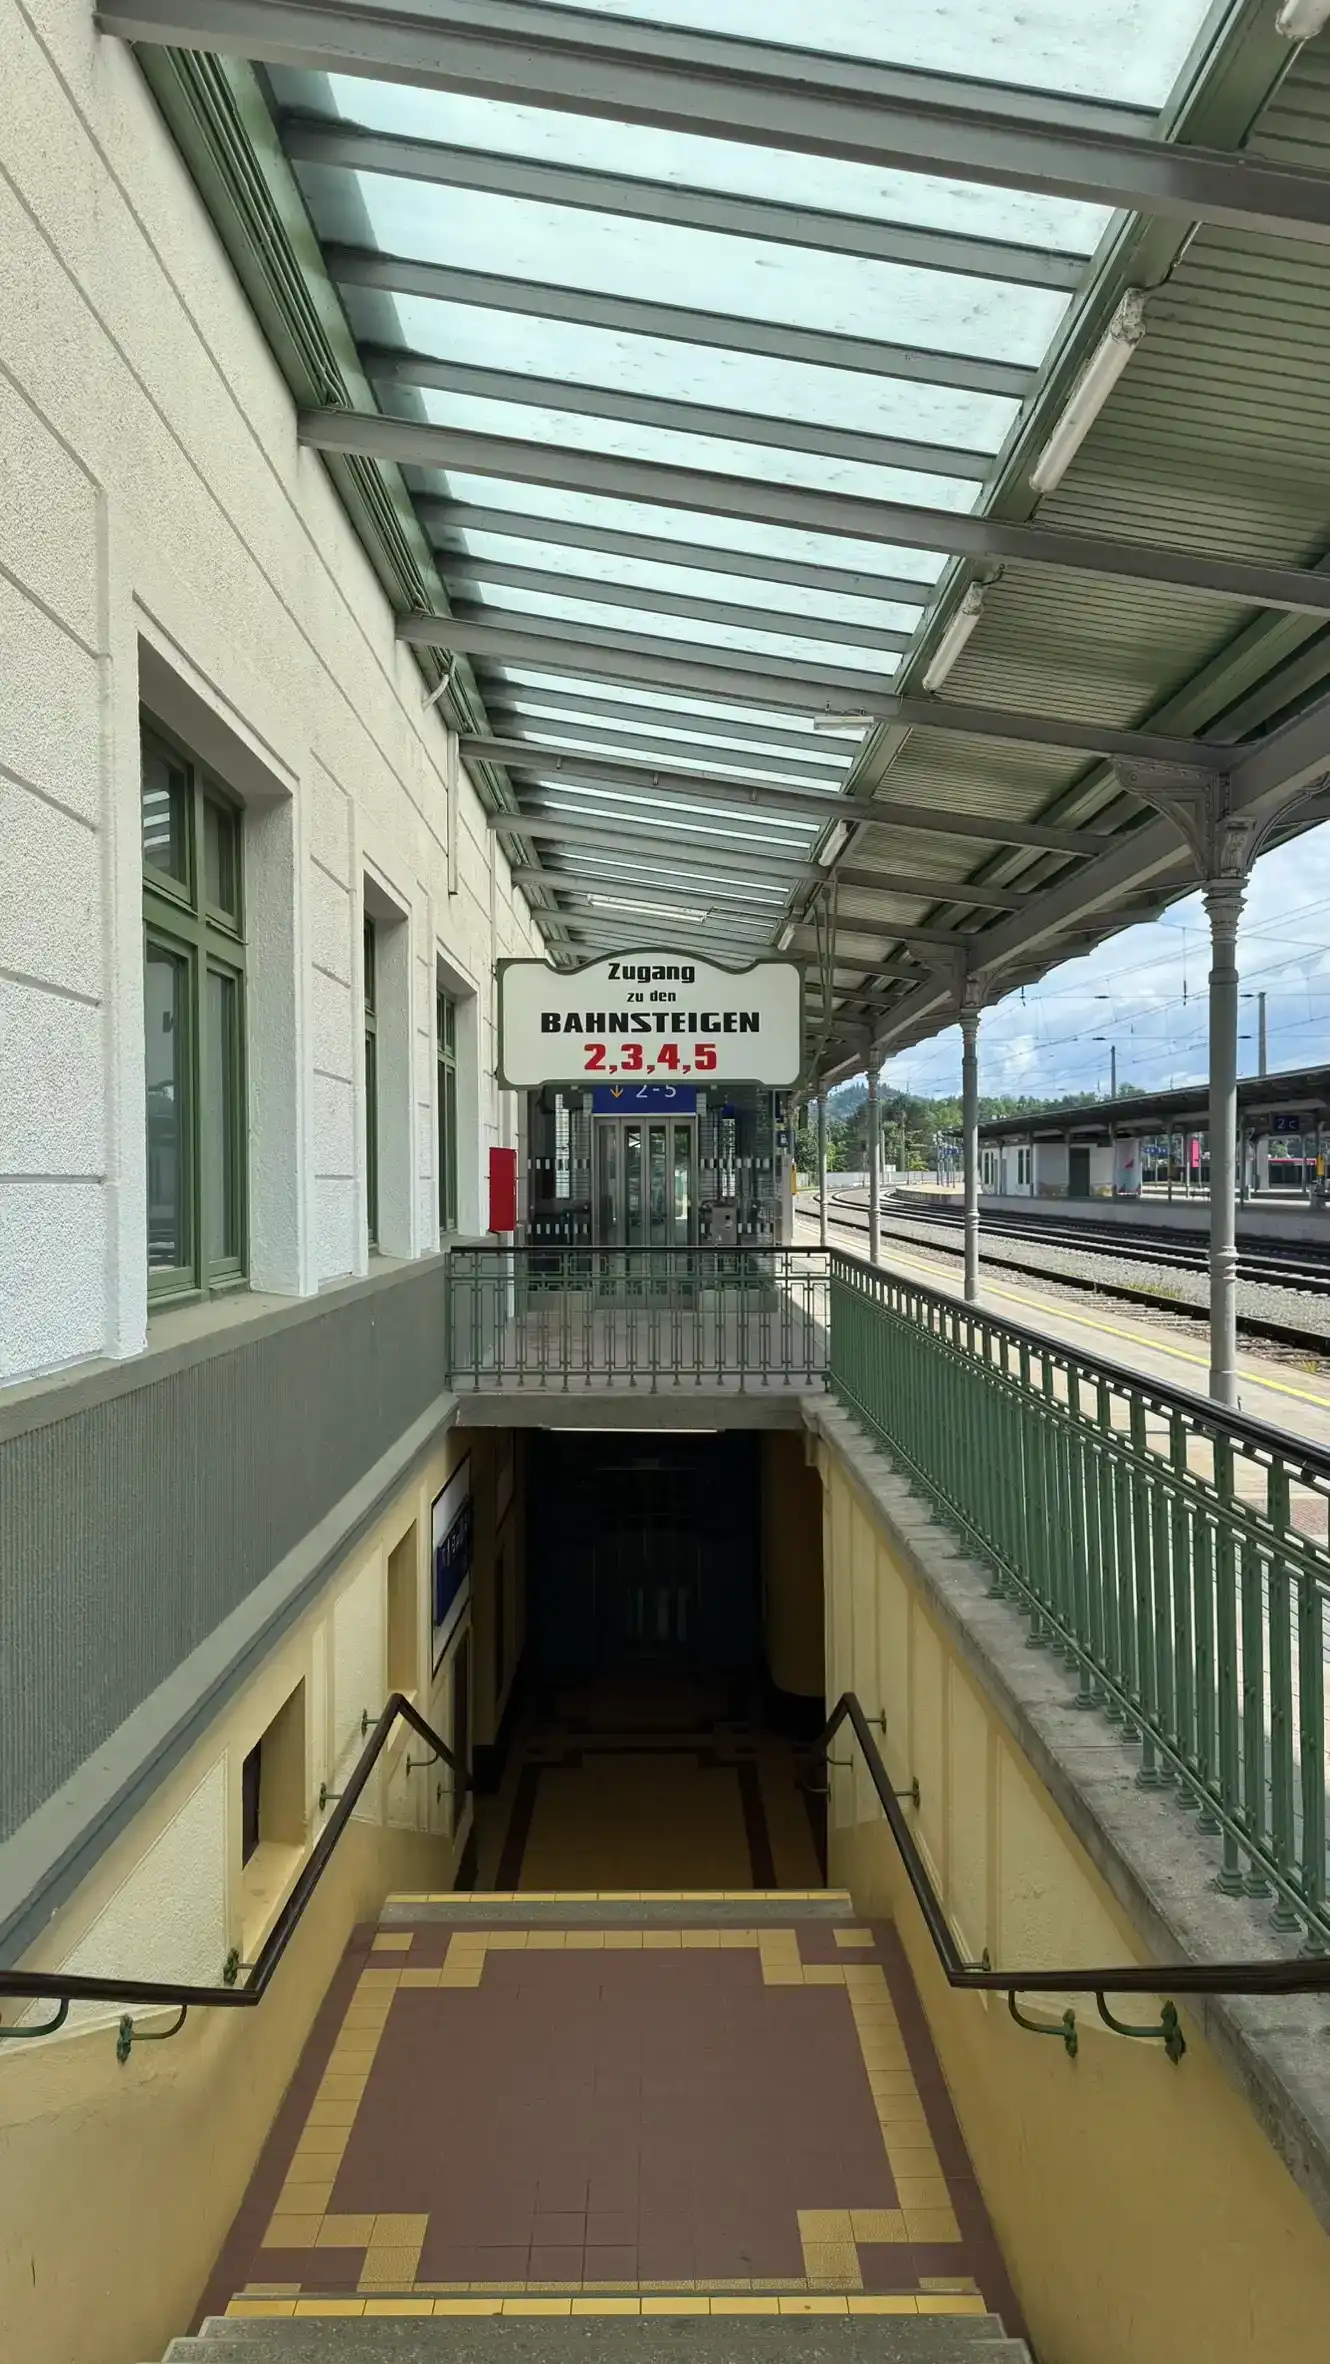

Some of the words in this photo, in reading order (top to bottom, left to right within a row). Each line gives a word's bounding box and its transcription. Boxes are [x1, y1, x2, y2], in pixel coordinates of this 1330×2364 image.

[608, 962, 695, 983] Zugang
[626, 991, 644, 1003] zu
[649, 990, 677, 1002] den
[541, 1012, 760, 1033] BAHNSTEIGEN
[584, 1043, 718, 1075] 2,3,4,5
[1277, 1118, 1284, 1128] 2
